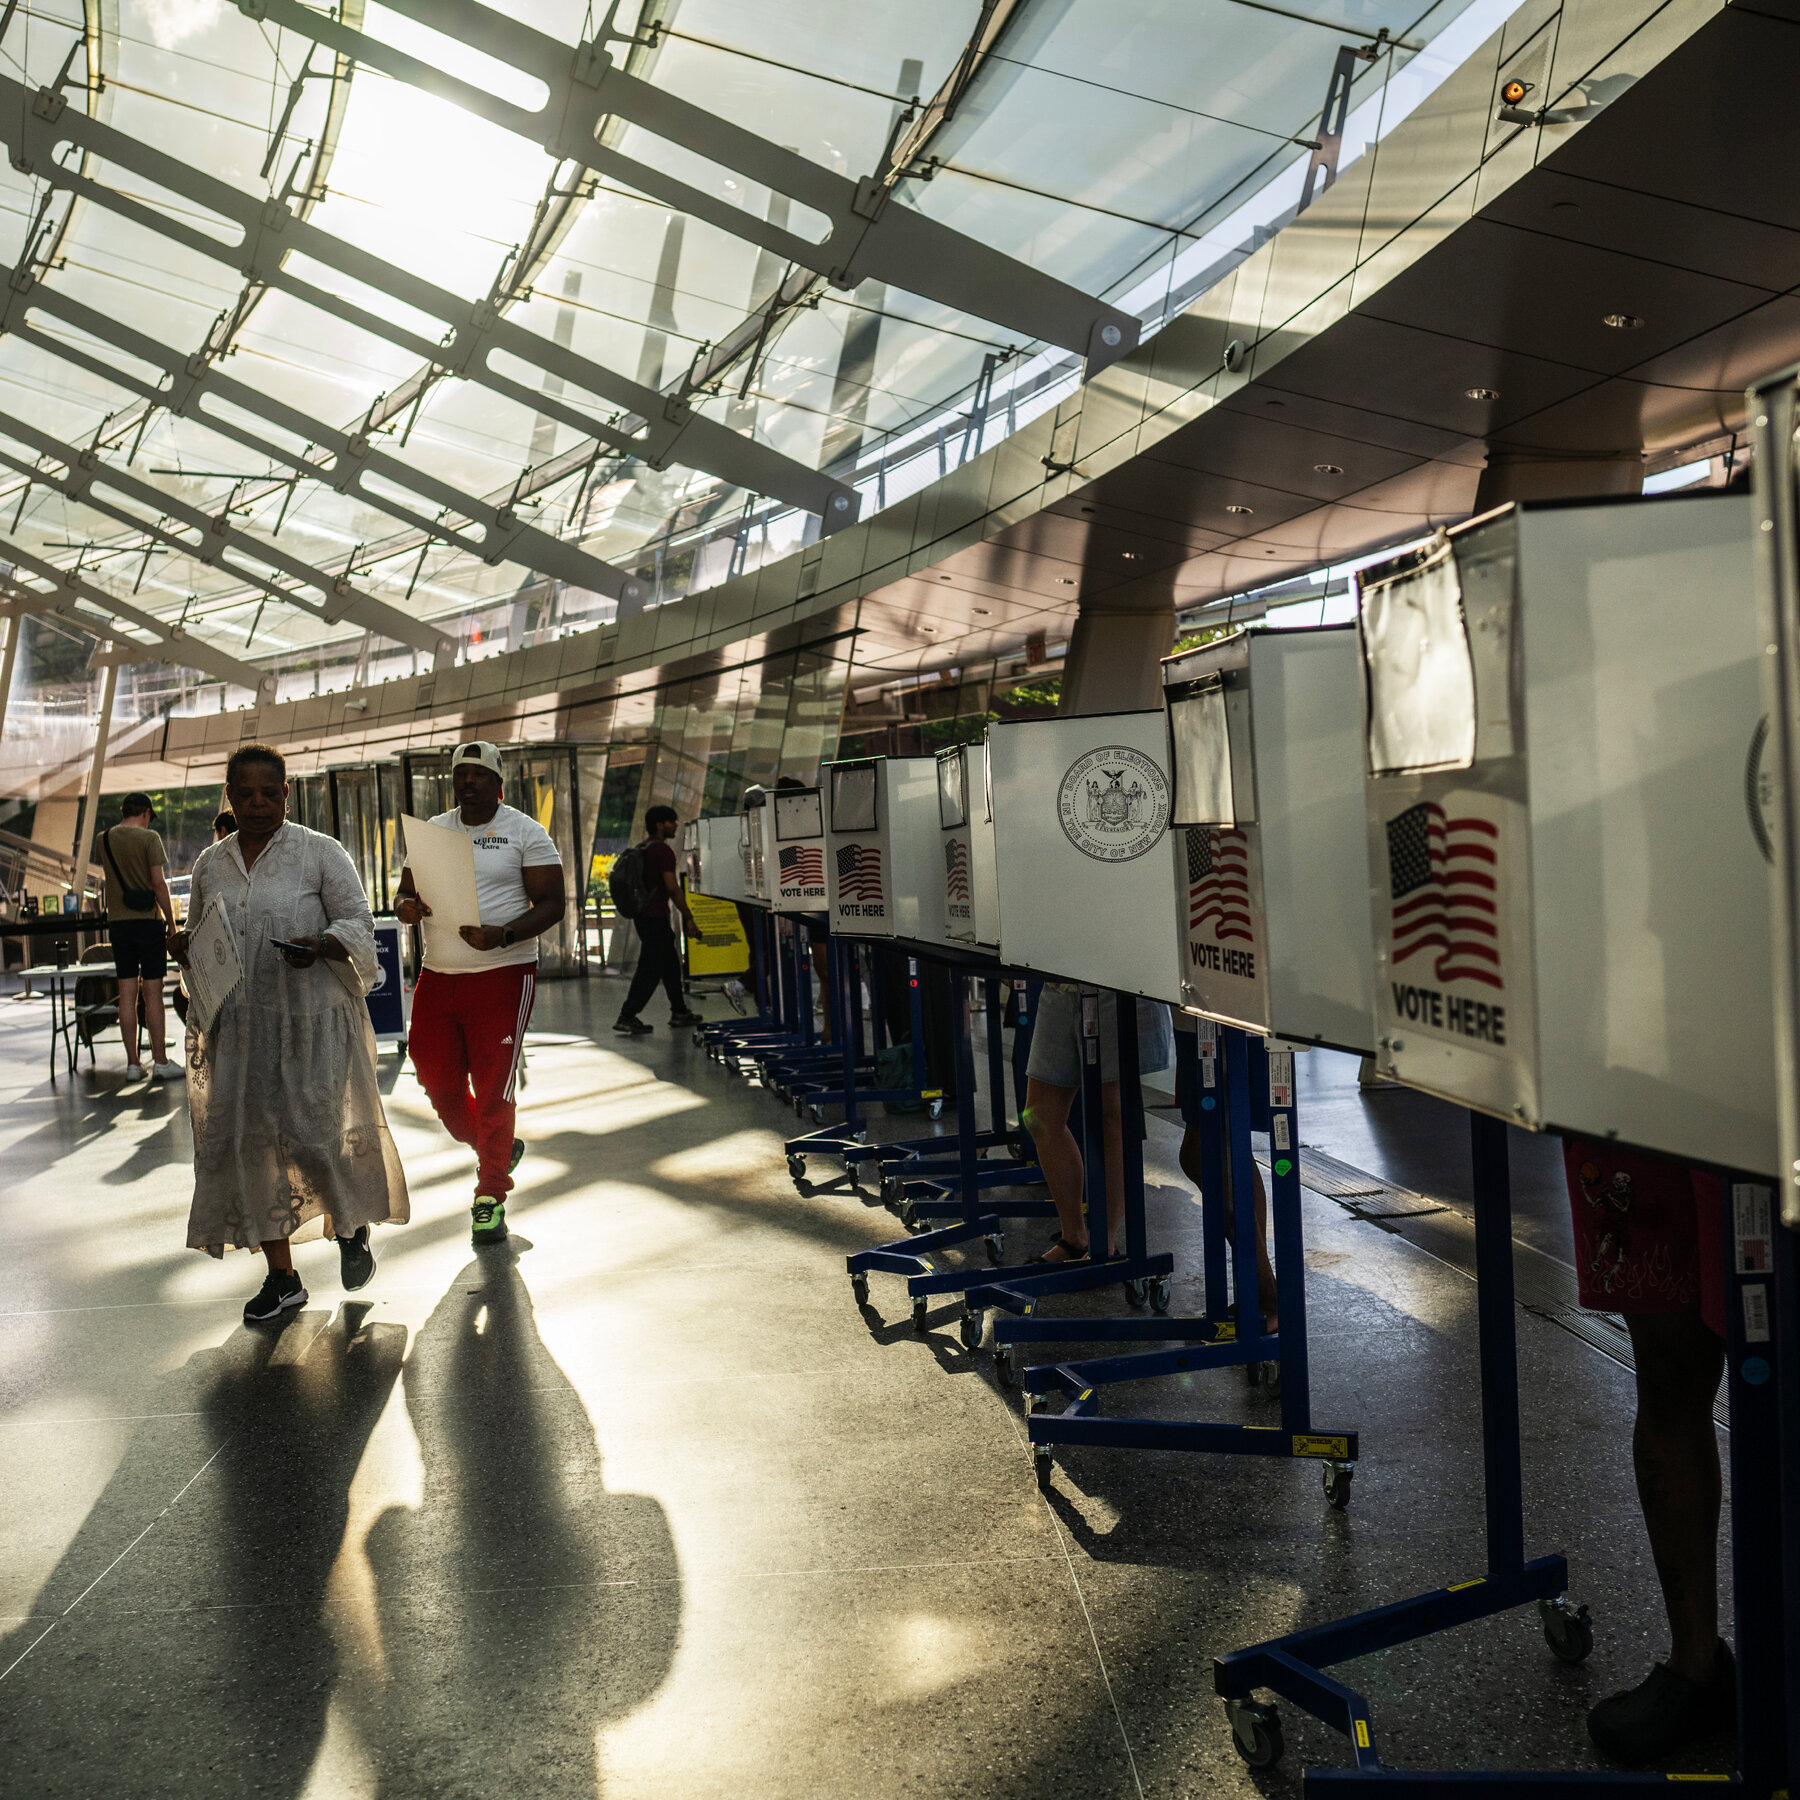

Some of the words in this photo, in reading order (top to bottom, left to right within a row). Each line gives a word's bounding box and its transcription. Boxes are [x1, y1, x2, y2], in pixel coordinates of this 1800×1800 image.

[1065, 758, 1094, 791] BOARD
[1095, 751, 1110, 761] OF
[1114, 751, 1164, 791] ELECTIONS
[1062, 802, 1071, 816] IN
[1150, 803, 1167, 835] YORK
[1065, 818, 1082, 840] THE
[1081, 839, 1107, 856] CITY
[1110, 848, 1126, 858] OF
[1128, 834, 1152, 855] NEW
[780, 888, 801, 897] VOTE
[803, 887, 825, 896] HERE
[839, 904, 860, 917] VOTE
[862, 904, 885, 917] HERE
[1190, 941, 1220, 971] VOTE
[1222, 948, 1255, 979] HERE
[1391, 982, 1443, 1029] VOTE
[1446, 995, 1506, 1046] HERE
